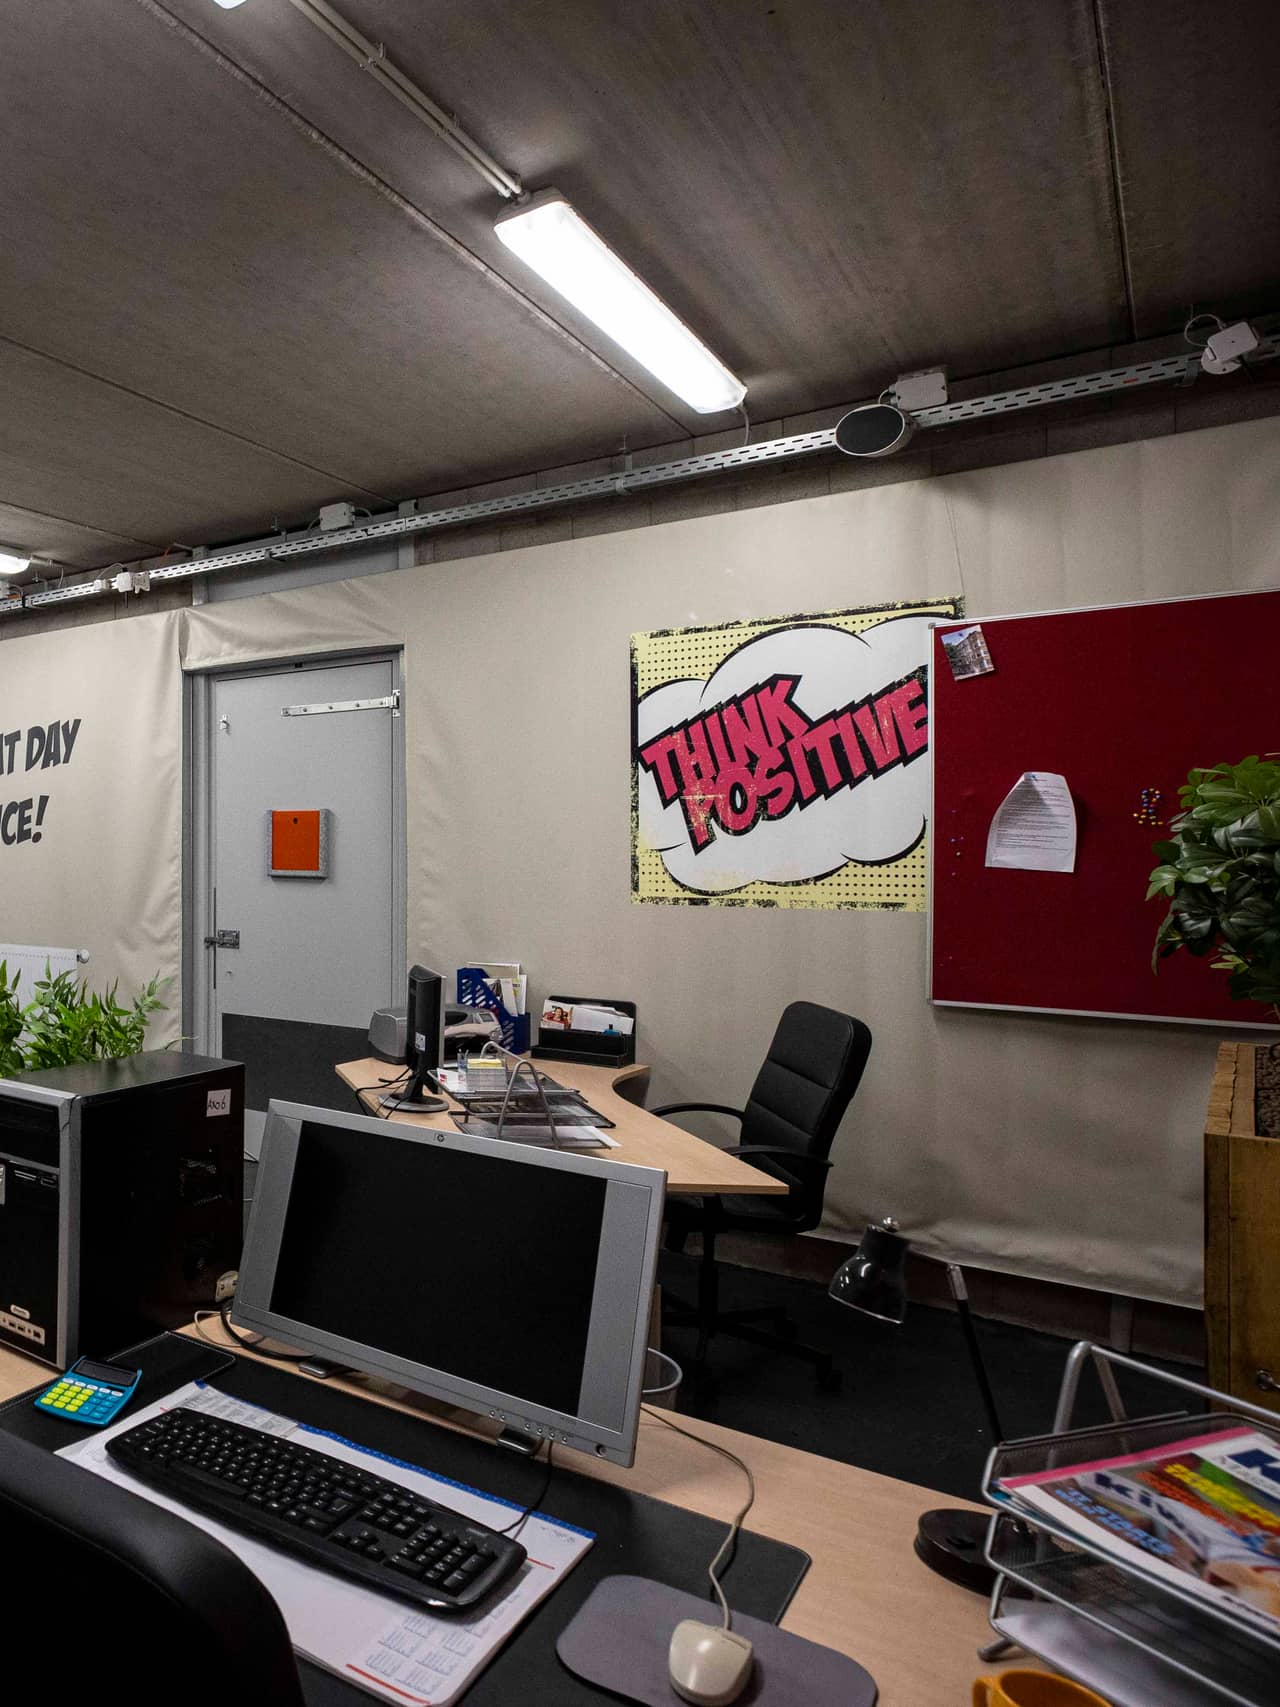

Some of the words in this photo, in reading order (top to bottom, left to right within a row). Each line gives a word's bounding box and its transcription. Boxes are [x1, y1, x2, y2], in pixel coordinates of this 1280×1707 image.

[25, 718, 82, 771] DAY
[639, 677, 811, 806] THINK
[680, 671, 929, 851] POSITIVE
